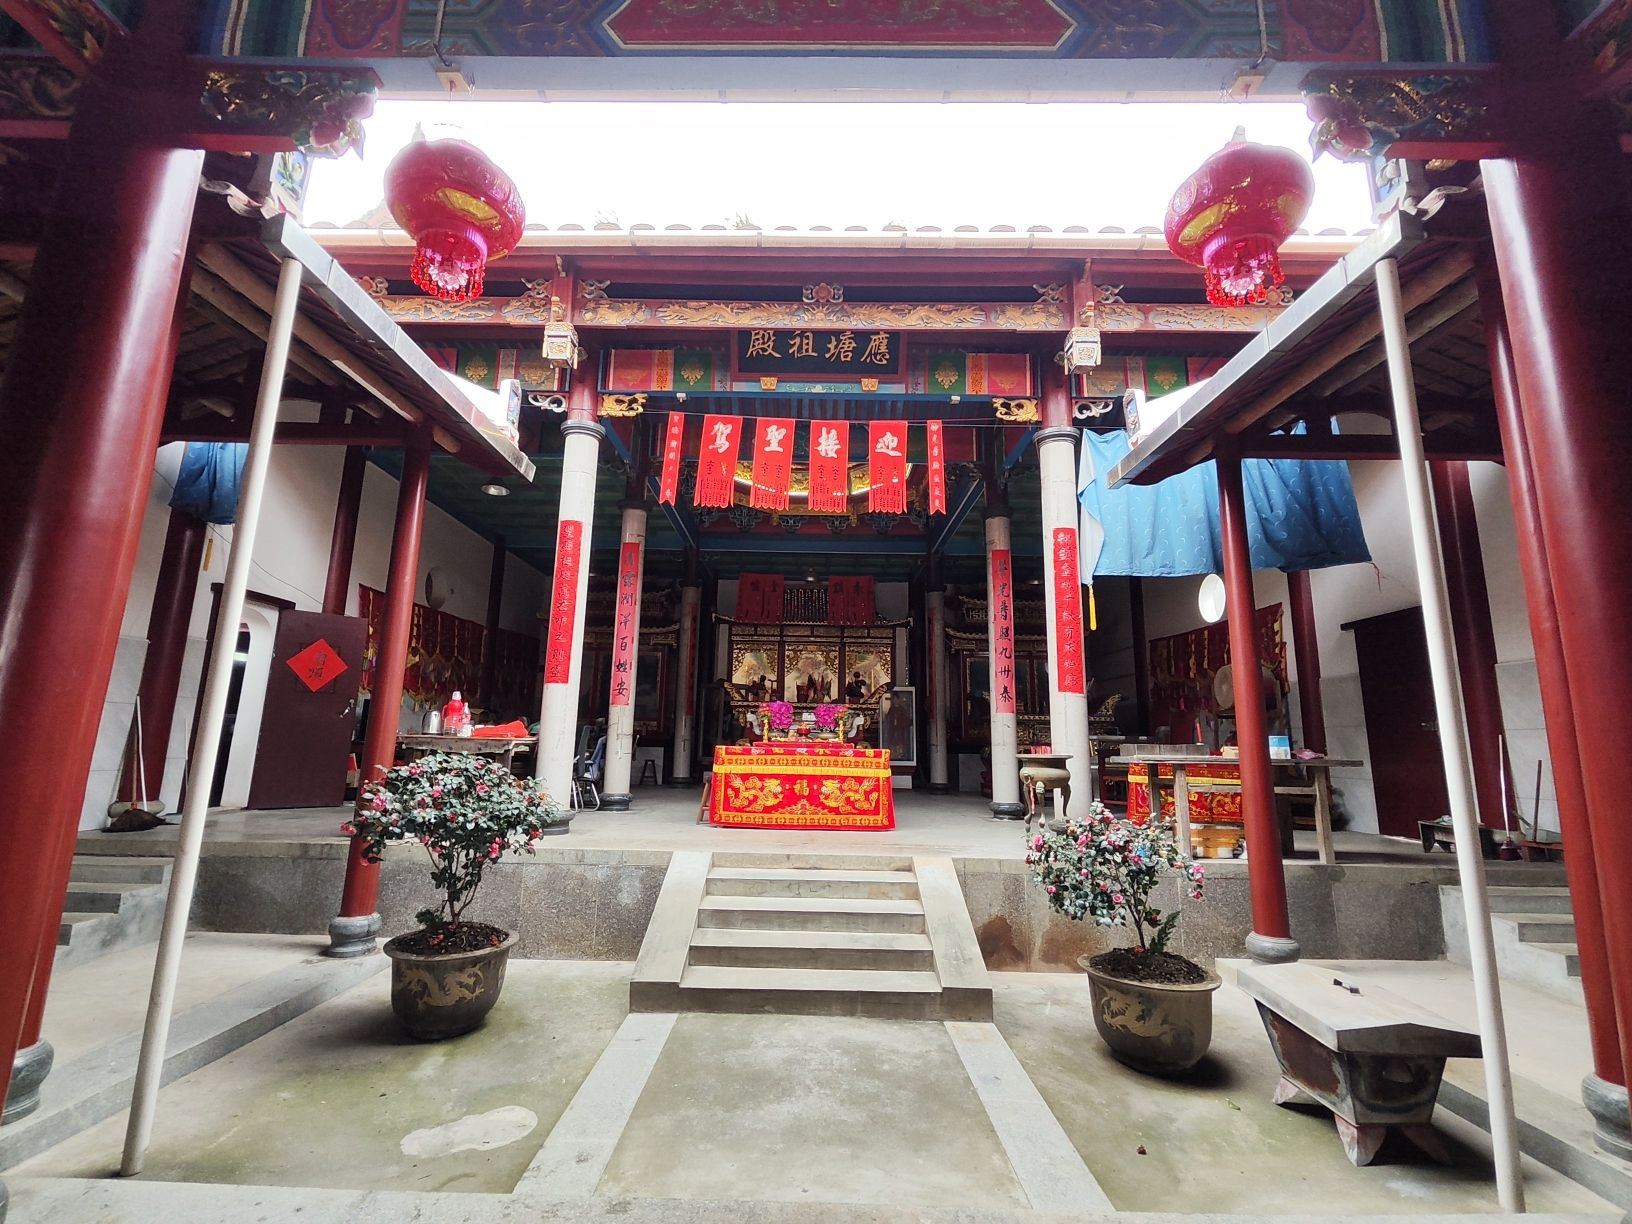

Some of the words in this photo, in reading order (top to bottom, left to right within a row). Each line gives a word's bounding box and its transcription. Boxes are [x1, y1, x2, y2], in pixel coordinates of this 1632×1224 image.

[746, 330, 891, 365] 應塘祖殿
[793, 779, 810, 796] 福
